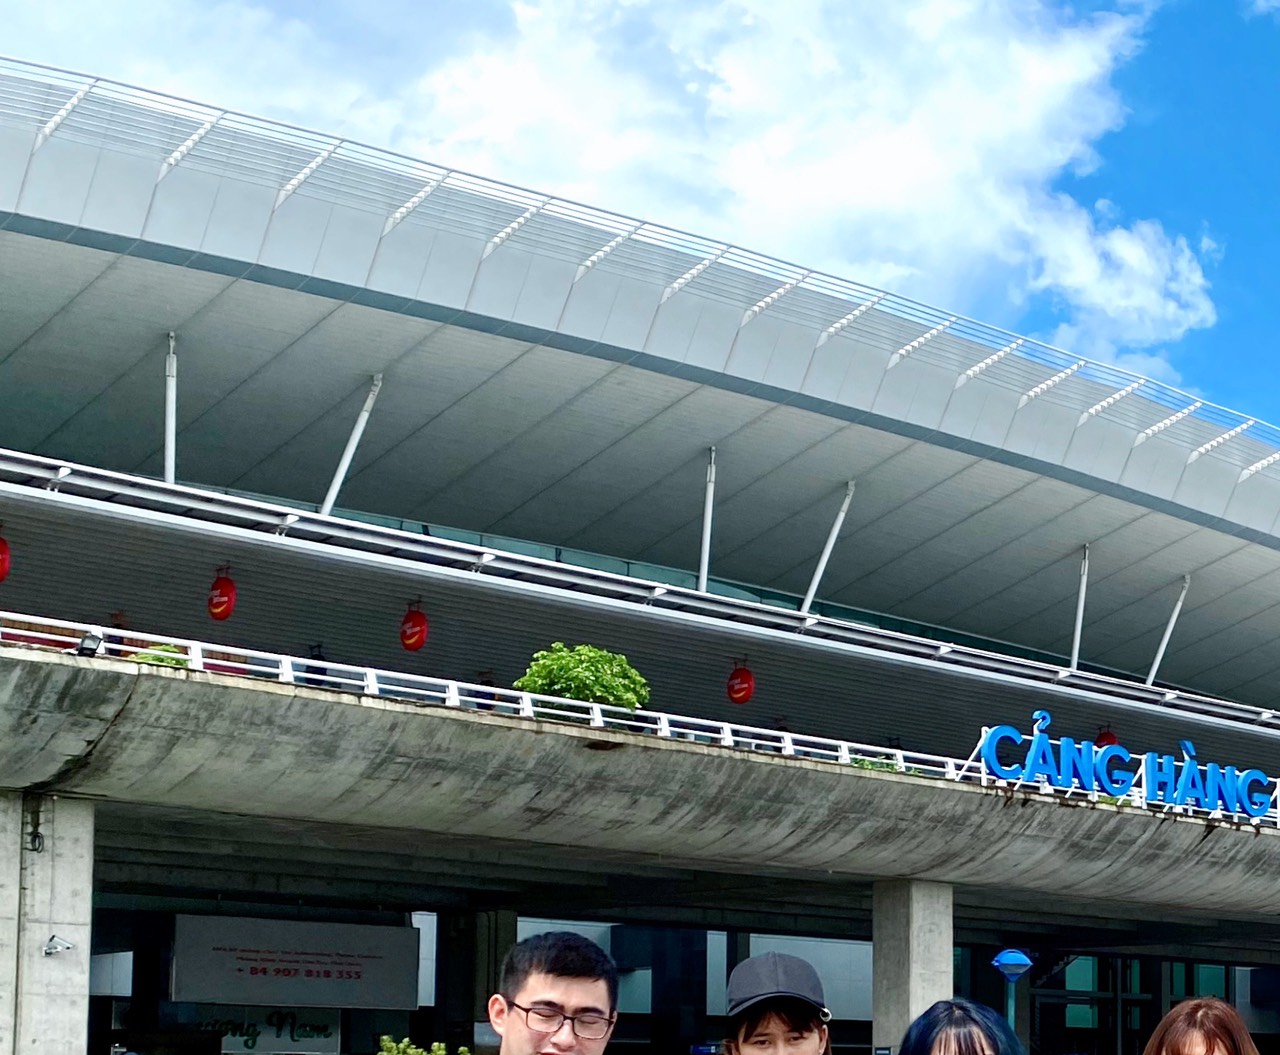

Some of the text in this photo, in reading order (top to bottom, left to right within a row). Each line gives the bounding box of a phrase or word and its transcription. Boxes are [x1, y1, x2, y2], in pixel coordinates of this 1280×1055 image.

[981, 709, 1135, 796] CẢNG
[1146, 740, 1271, 817] HÀNG
[249, 966, 268, 976] 84
[273, 967, 299, 977] 907
